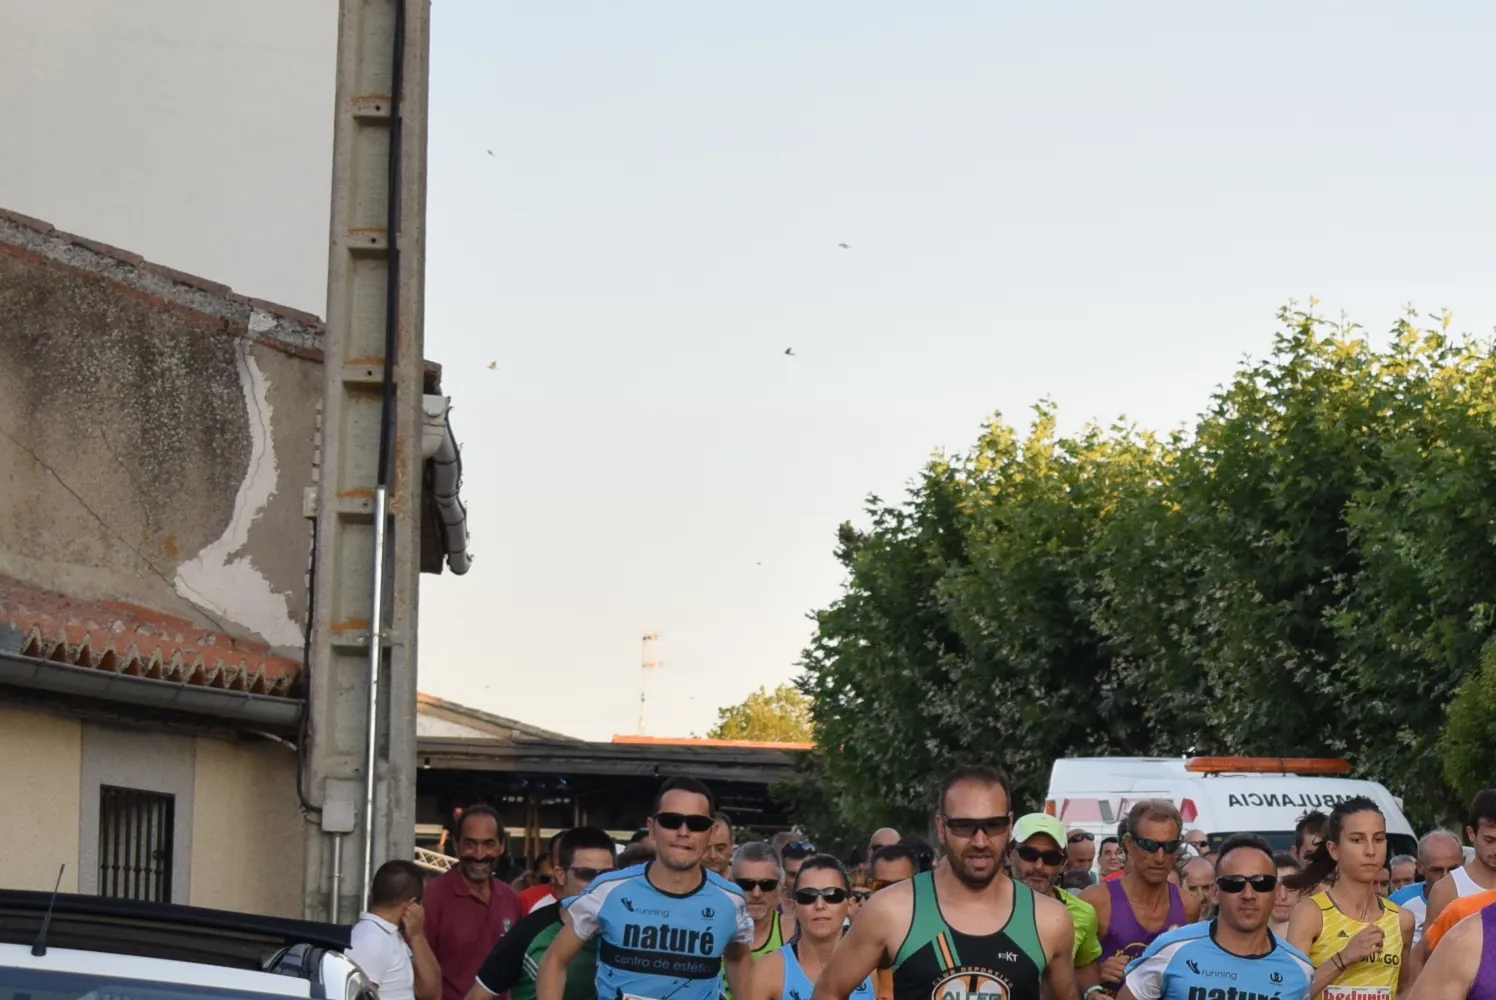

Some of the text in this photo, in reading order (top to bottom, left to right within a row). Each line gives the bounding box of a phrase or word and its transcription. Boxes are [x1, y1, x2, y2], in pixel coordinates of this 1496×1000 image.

[636, 907, 669, 918] running
[622, 923, 715, 955] naturé
[614, 954, 650, 968] centro
[653, 958, 670, 969] de
[1383, 953, 1400, 966] GO
[1202, 969, 1238, 981] running
